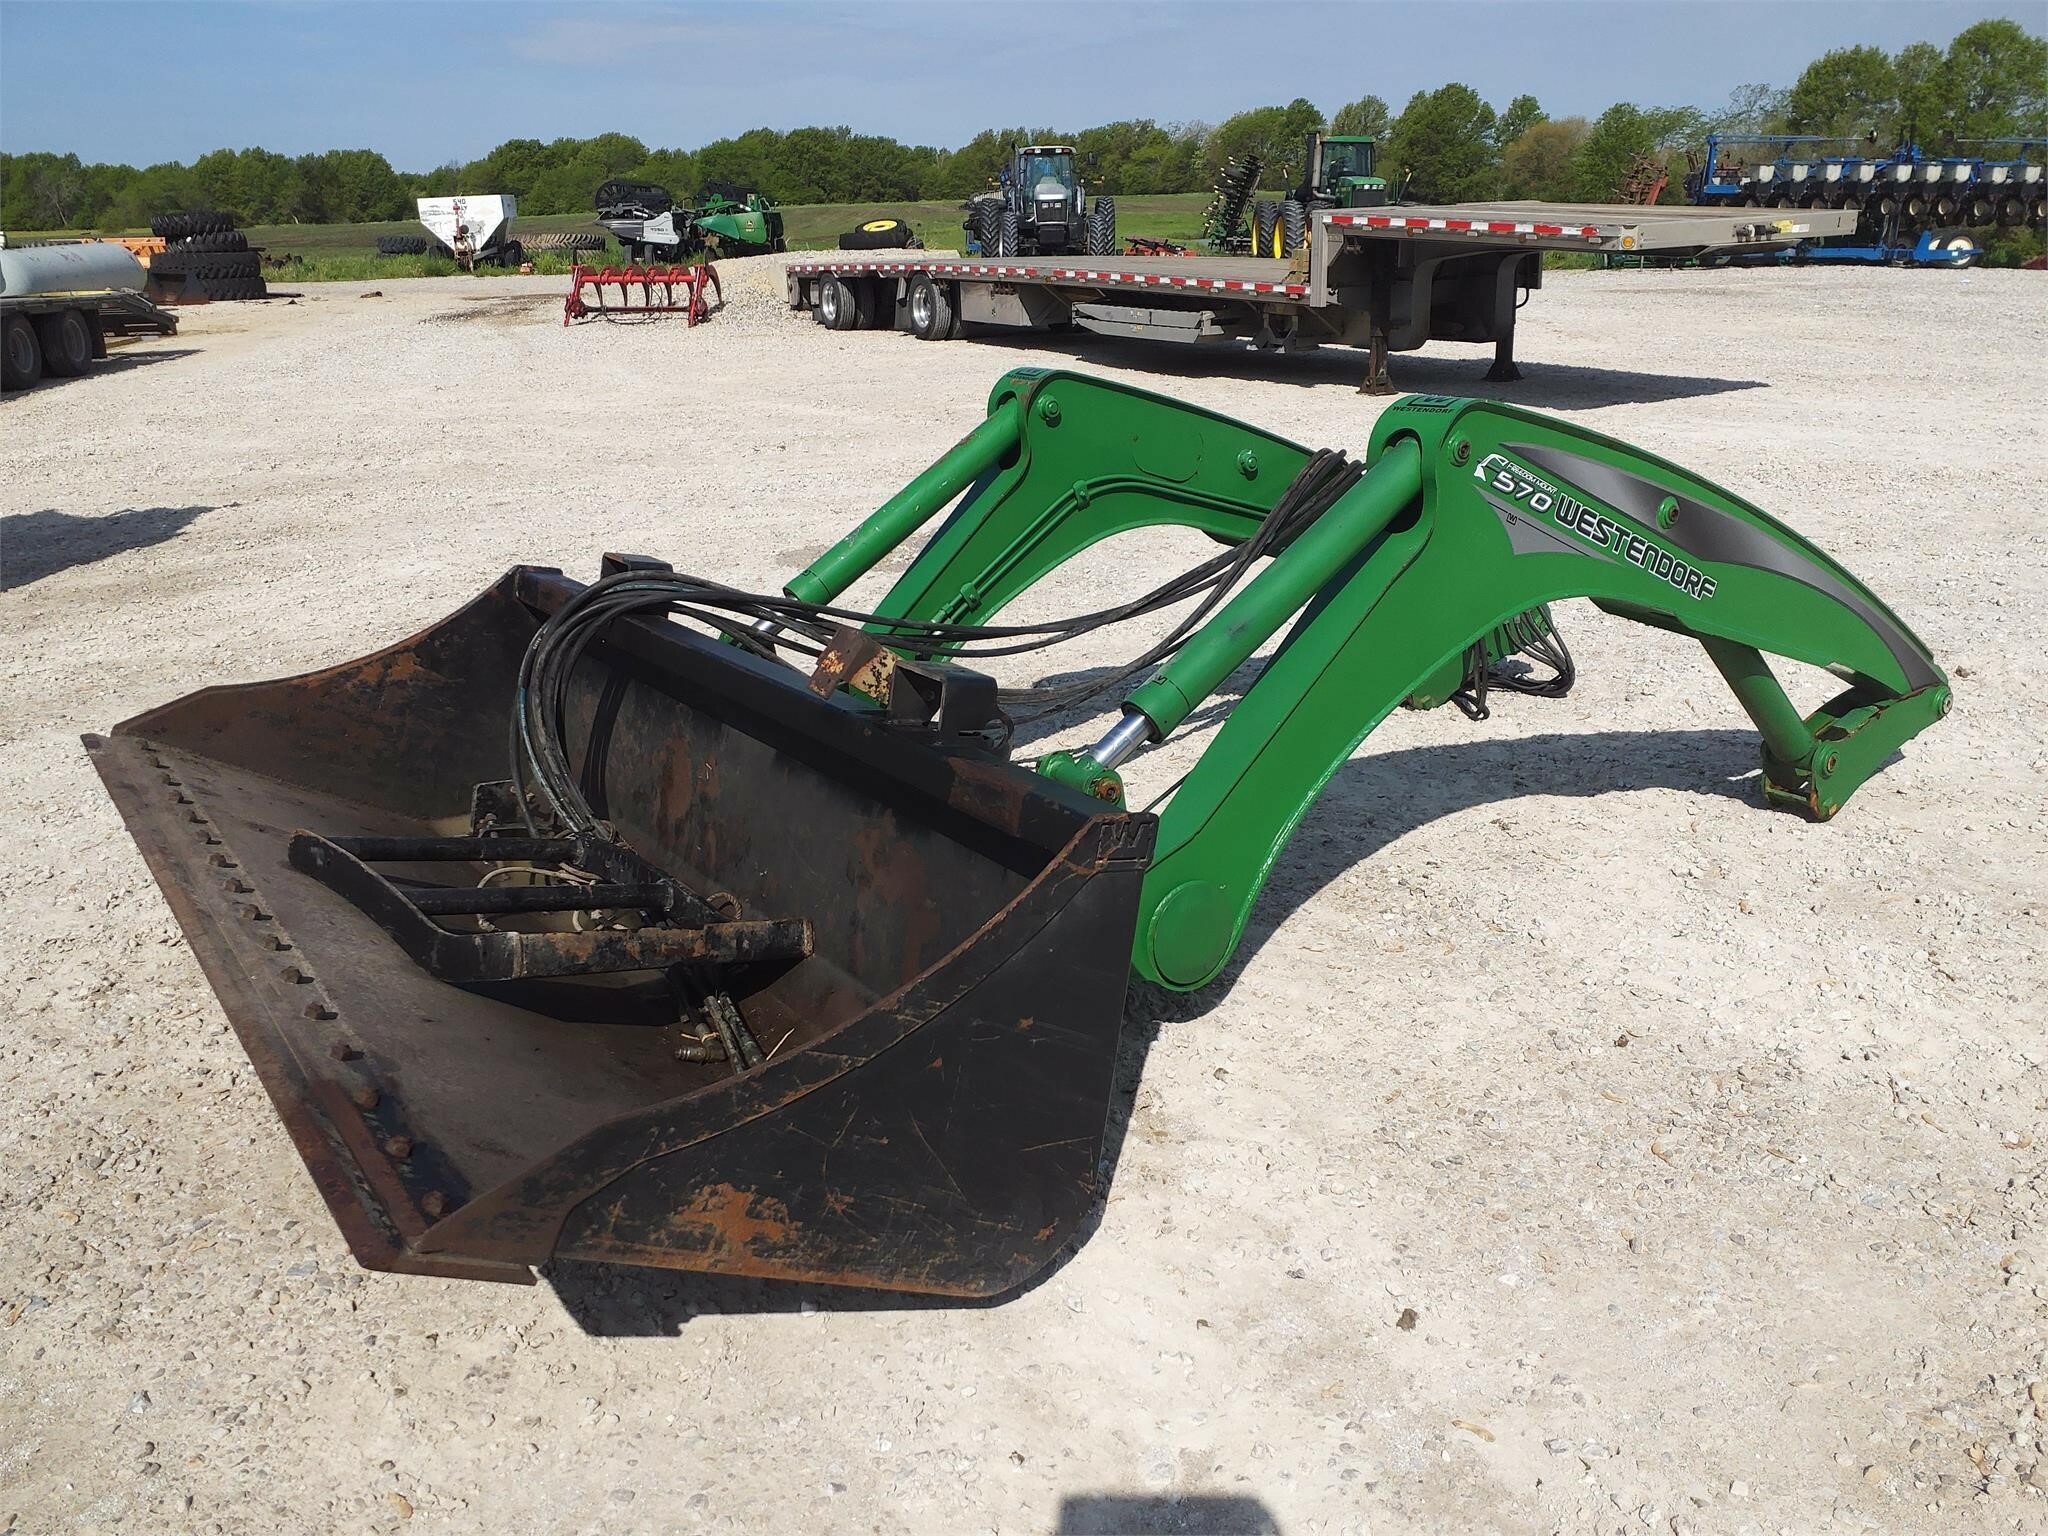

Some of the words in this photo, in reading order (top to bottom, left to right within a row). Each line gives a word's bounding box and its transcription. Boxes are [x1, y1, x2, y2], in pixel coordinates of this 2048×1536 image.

[1392, 405, 1454, 414] WESTENDORF
[1506, 461, 1537, 484] FREEDOM
[1491, 470, 1553, 513] 570
[1554, 492, 1718, 600] WESTENDORF
